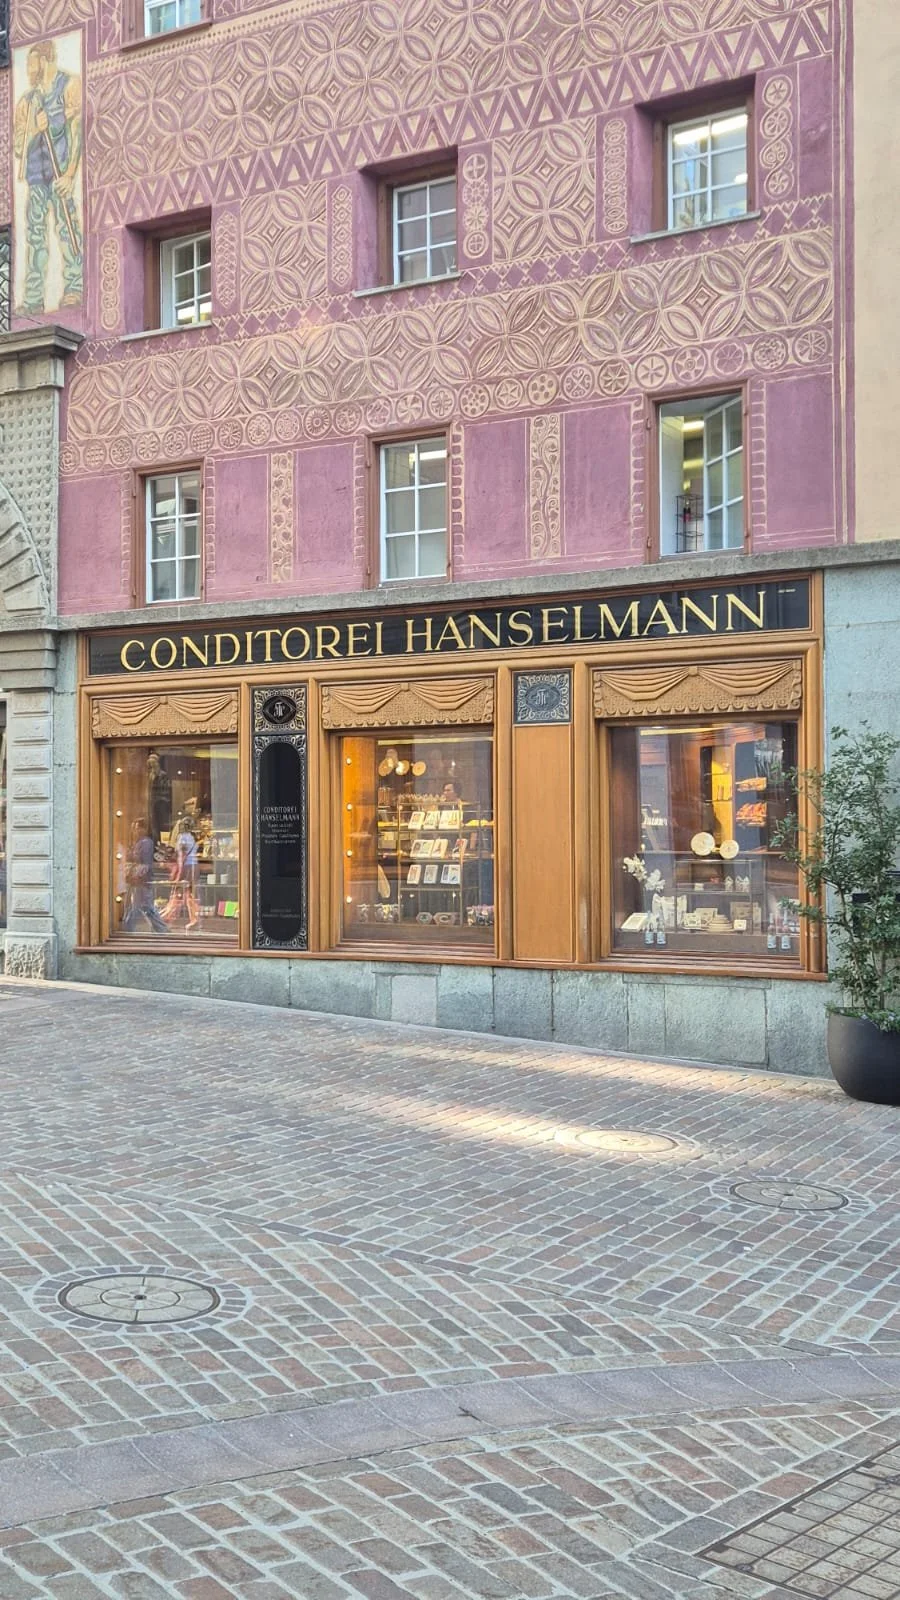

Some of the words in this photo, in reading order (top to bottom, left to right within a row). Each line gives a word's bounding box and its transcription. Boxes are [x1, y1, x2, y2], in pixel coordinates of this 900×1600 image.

[120, 621, 384, 671] CONDITOREI
[406, 591, 766, 653] HANSELMANN
[263, 806, 297, 814] CONDITOREI
[260, 814, 300, 822] HANSELMANN
